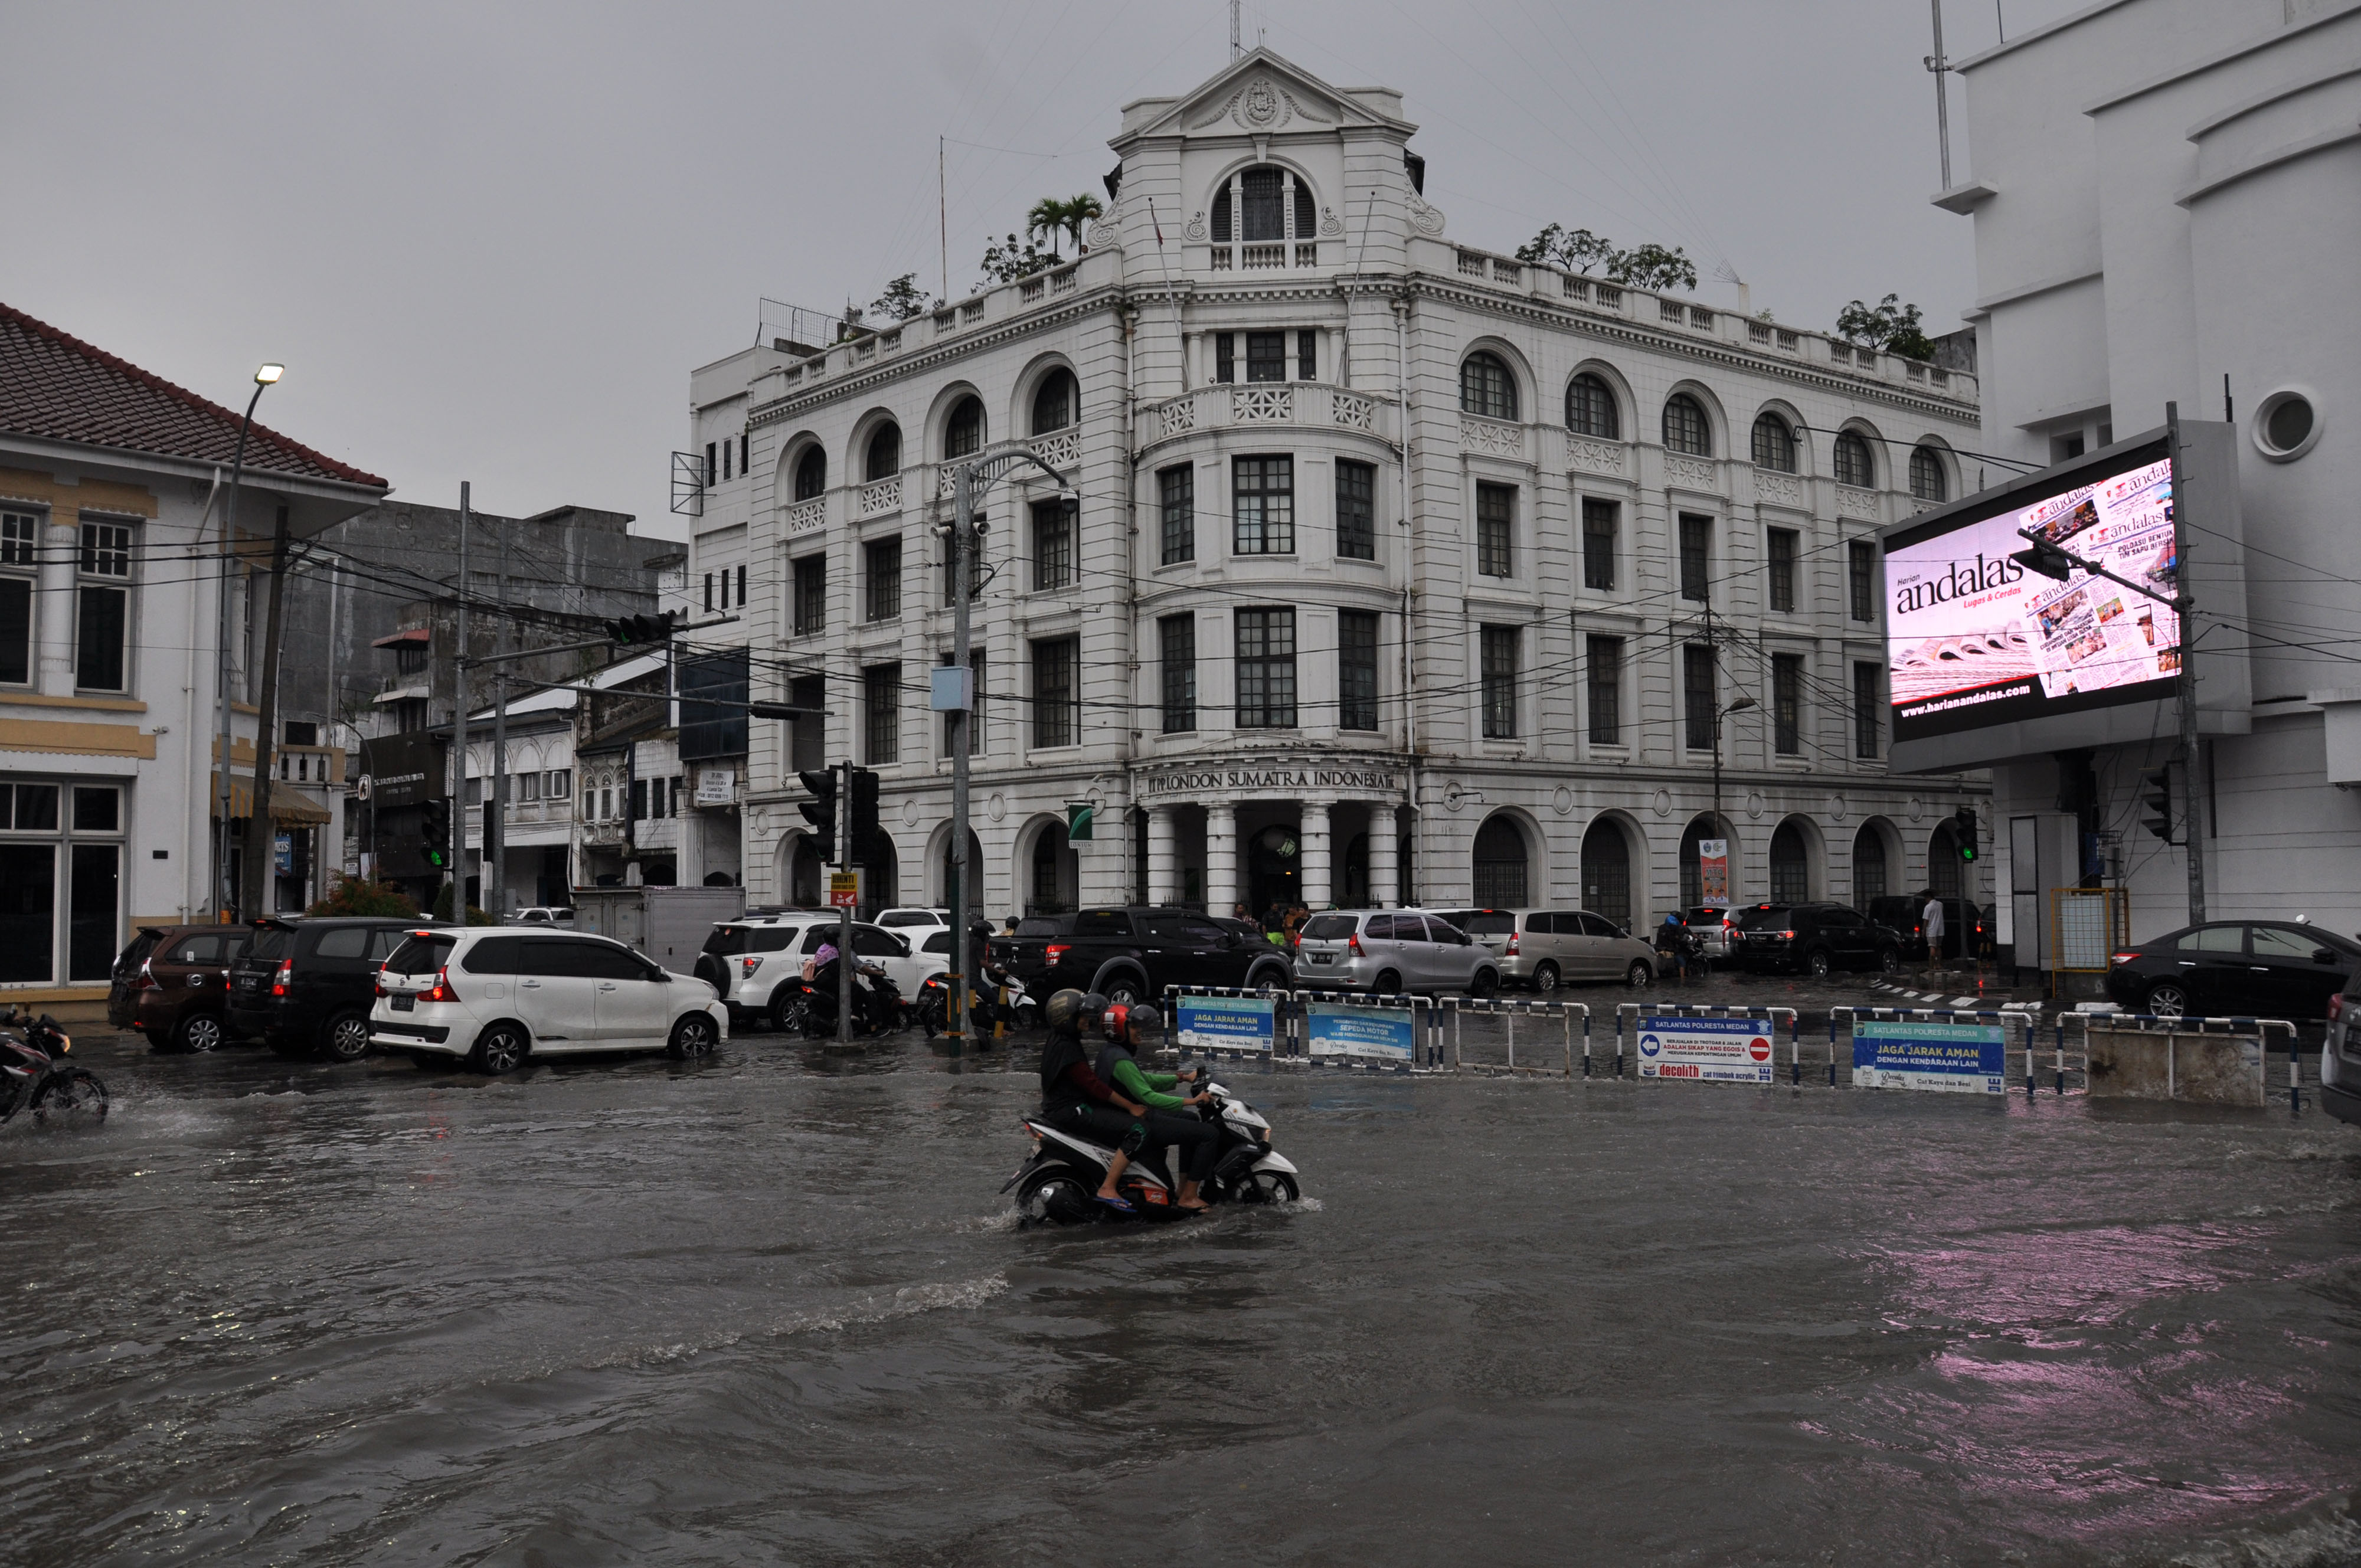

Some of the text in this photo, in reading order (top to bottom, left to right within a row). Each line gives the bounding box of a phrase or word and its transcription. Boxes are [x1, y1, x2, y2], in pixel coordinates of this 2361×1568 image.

[2110, 512, 2163, 538] andalas
[2117, 538, 2147, 552] POLDASU
[2148, 529, 2173, 542] BENTUK
[2119, 550, 2130, 559] TIM
[2131, 545, 2149, 555] SAPU
[1896, 552, 2024, 614] andalas
[1897, 574, 1920, 587] Harian
[2043, 571, 2086, 603] andalas
[1963, 596, 1986, 608] Lugas
[1994, 587, 2022, 600] Cerdas
[1901, 685, 2031, 718] www.harianandalas.com
[1149, 778, 1156, 793] PT
[1157, 778, 1166, 791] PP
[1166, 773, 1222, 790] LONDON
[1228, 771, 1308, 786] SUMATRA
[1314, 771, 1384, 788] INDONESIA
[1340, 1024, 1389, 1035] SEPEDA MOTOR
[1877, 1045, 1979, 1058] JAGA JARAK AMAN
[1910, 1058, 1958, 1066] KENDARAAN
[1659, 1063, 1699, 1078] decolith
[1735, 1072, 1756, 1080] acrylic
